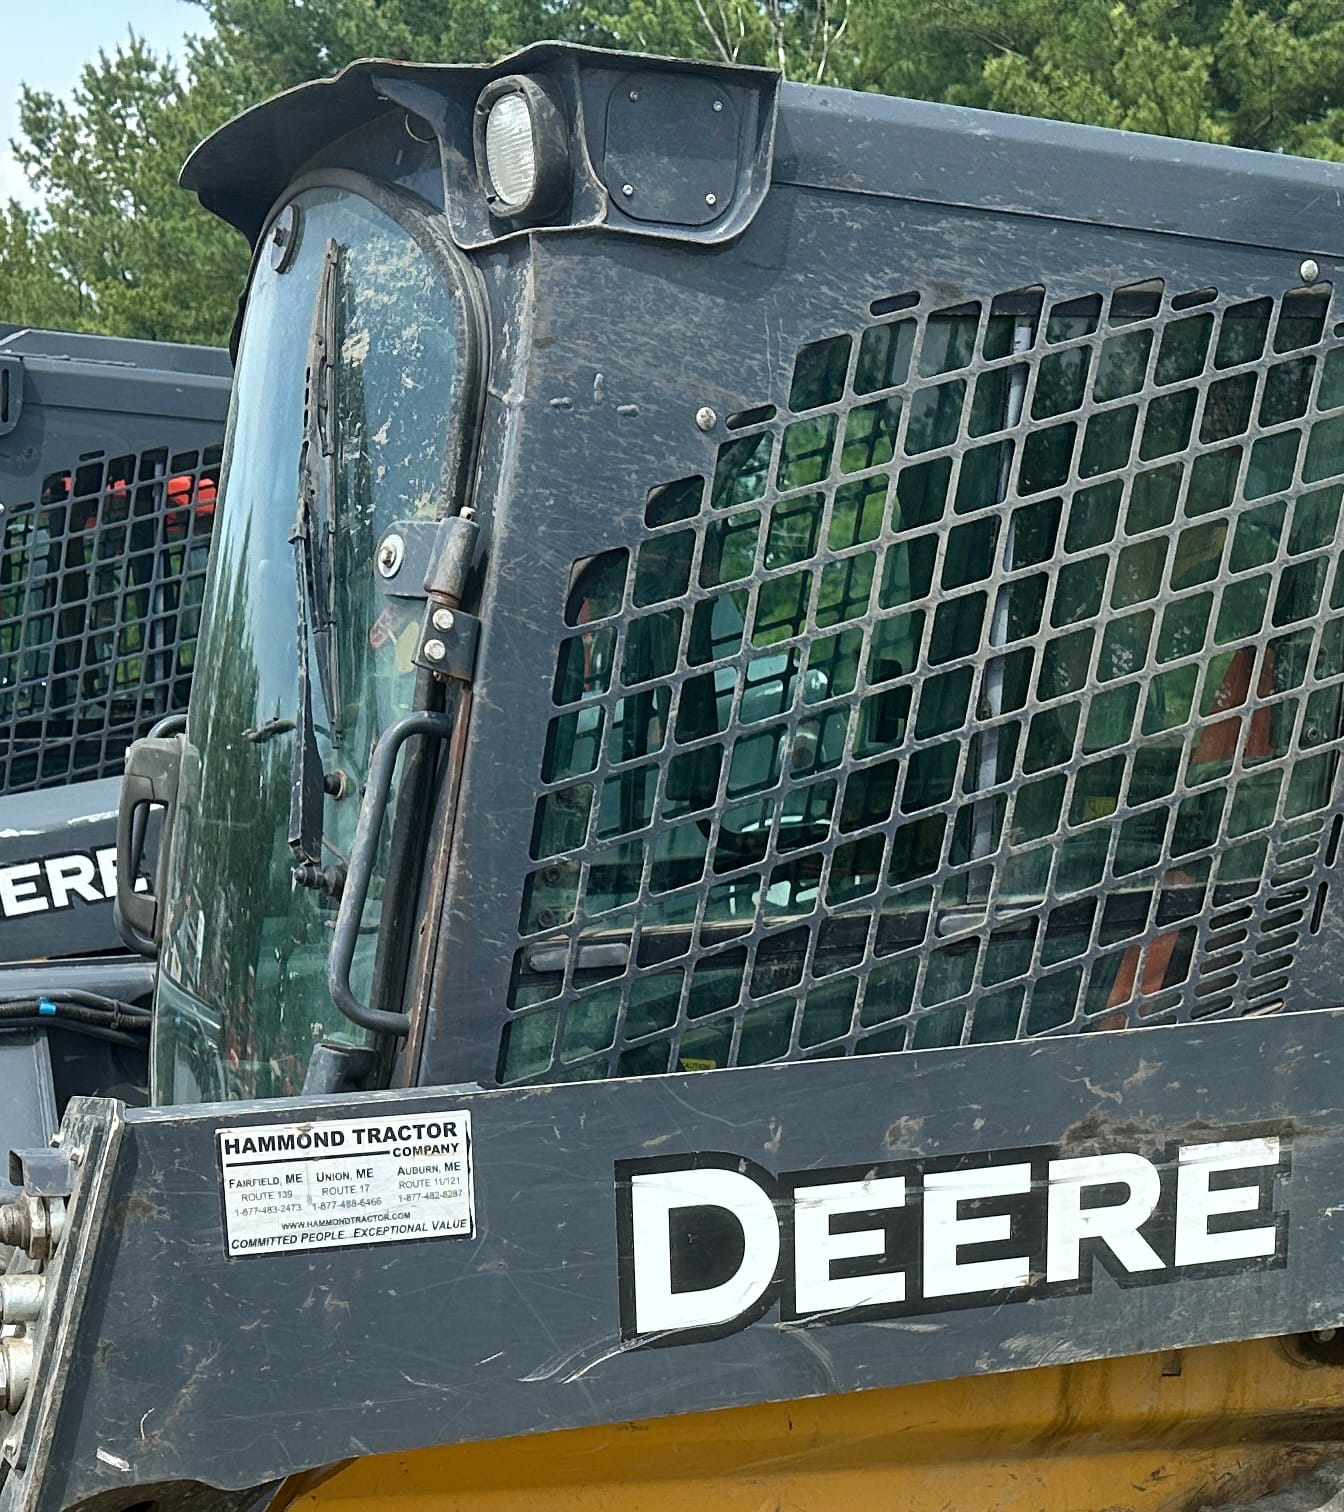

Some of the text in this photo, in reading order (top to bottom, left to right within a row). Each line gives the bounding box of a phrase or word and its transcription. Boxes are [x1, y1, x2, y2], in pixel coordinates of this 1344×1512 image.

[224, 1121, 458, 1155] HAMMOND TRACTOR
[392, 1142, 460, 1158] COMPANY
[316, 1167, 375, 1183] UNION, ME
[397, 1161, 461, 1177] AUBURN, ME
[229, 1173, 304, 1189] FAIRFIELD, ME
[398, 1179, 432, 1190] ROUTE
[241, 1191, 274, 1202] ROUTE
[322, 1183, 370, 1197] ROUTE 17
[281, 1211, 411, 1230] WWW.HAMMONDTRACTOR.COM
[231, 1234, 298, 1250] COMMITTED
[353, 1223, 429, 1239] EXCEPTIONAL
[432, 1218, 468, 1231] VALUE
[631, 1135, 1281, 1334] DEERE
